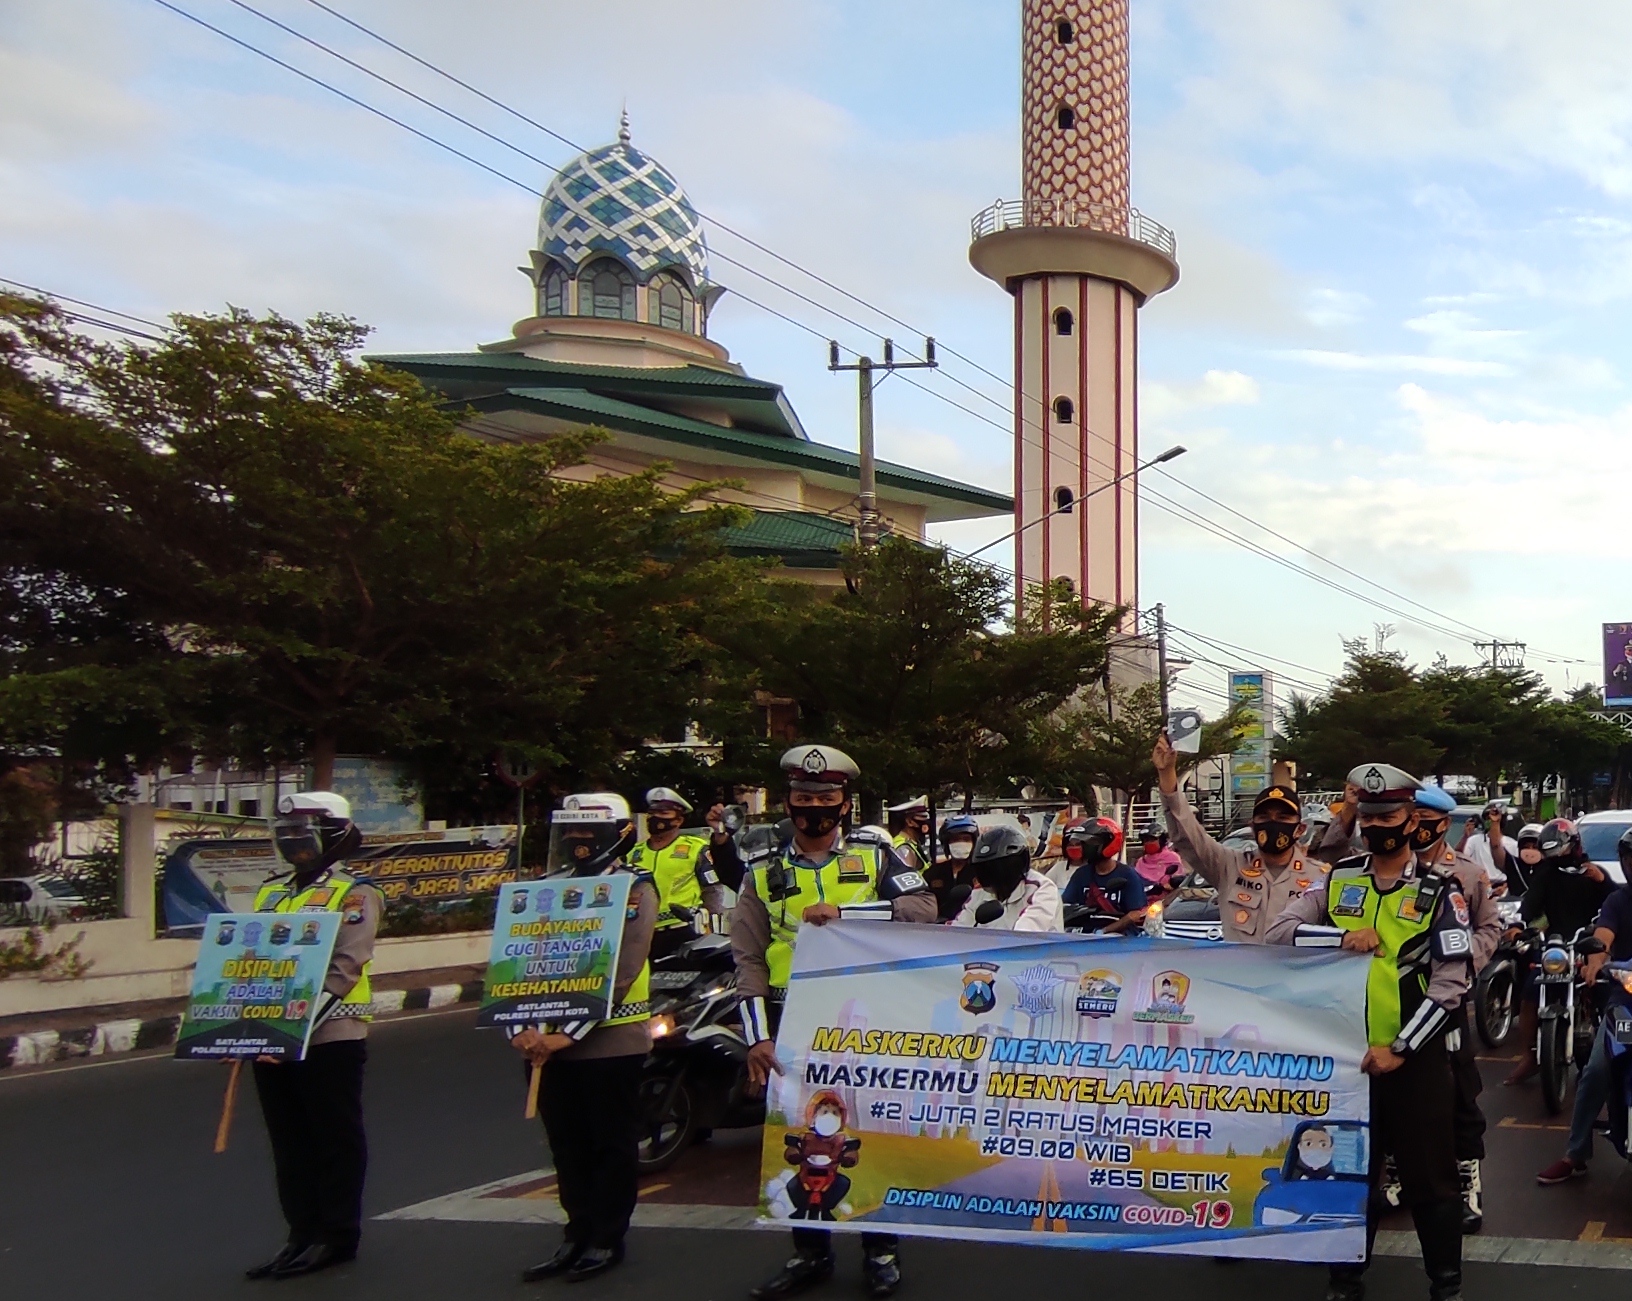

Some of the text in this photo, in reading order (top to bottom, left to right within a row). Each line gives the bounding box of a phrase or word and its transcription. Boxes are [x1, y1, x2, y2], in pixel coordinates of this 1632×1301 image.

[379, 852, 507, 876] BERAKTIVITAS
[413, 877, 460, 896] JAGA
[892, 872, 923, 892] B
[1235, 879, 1263, 891] MIKO
[509, 917, 605, 937] BUDAYAKAN
[504, 938, 604, 957] CUCI TANGAN
[1440, 928, 1470, 956] B
[222, 960, 298, 978] DISIPLIN
[525, 958, 578, 976] UNTUK
[226, 984, 286, 1000] ADALAH
[490, 977, 603, 998] KESEHATANMU
[191, 1000, 308, 1019] VAKSIN COVID 19
[494, 1008, 589, 1021] POLRES KEDIRI KOTA
[516, 1001, 570, 1011] SATLANTAS
[1078, 1002, 1115, 1011] SEMERU
[1618, 1022, 1630, 1032] AE
[261, 1046, 285, 1054] KOTA
[813, 1027, 1334, 1081] MASKERKU MENYELAMATKANMU
[806, 1063, 1330, 1116] MASKERMU MENYELAMATKANKU
[870, 1101, 1211, 1139] #2 JUTA 2 RATUS MASKER
[982, 1136, 1132, 1163] #09.00 WIB
[1089, 1169, 1229, 1191] #65 DETIK
[885, 1188, 1233, 1228] DISIPLIN ADALAH VAKSIN COVID-19
